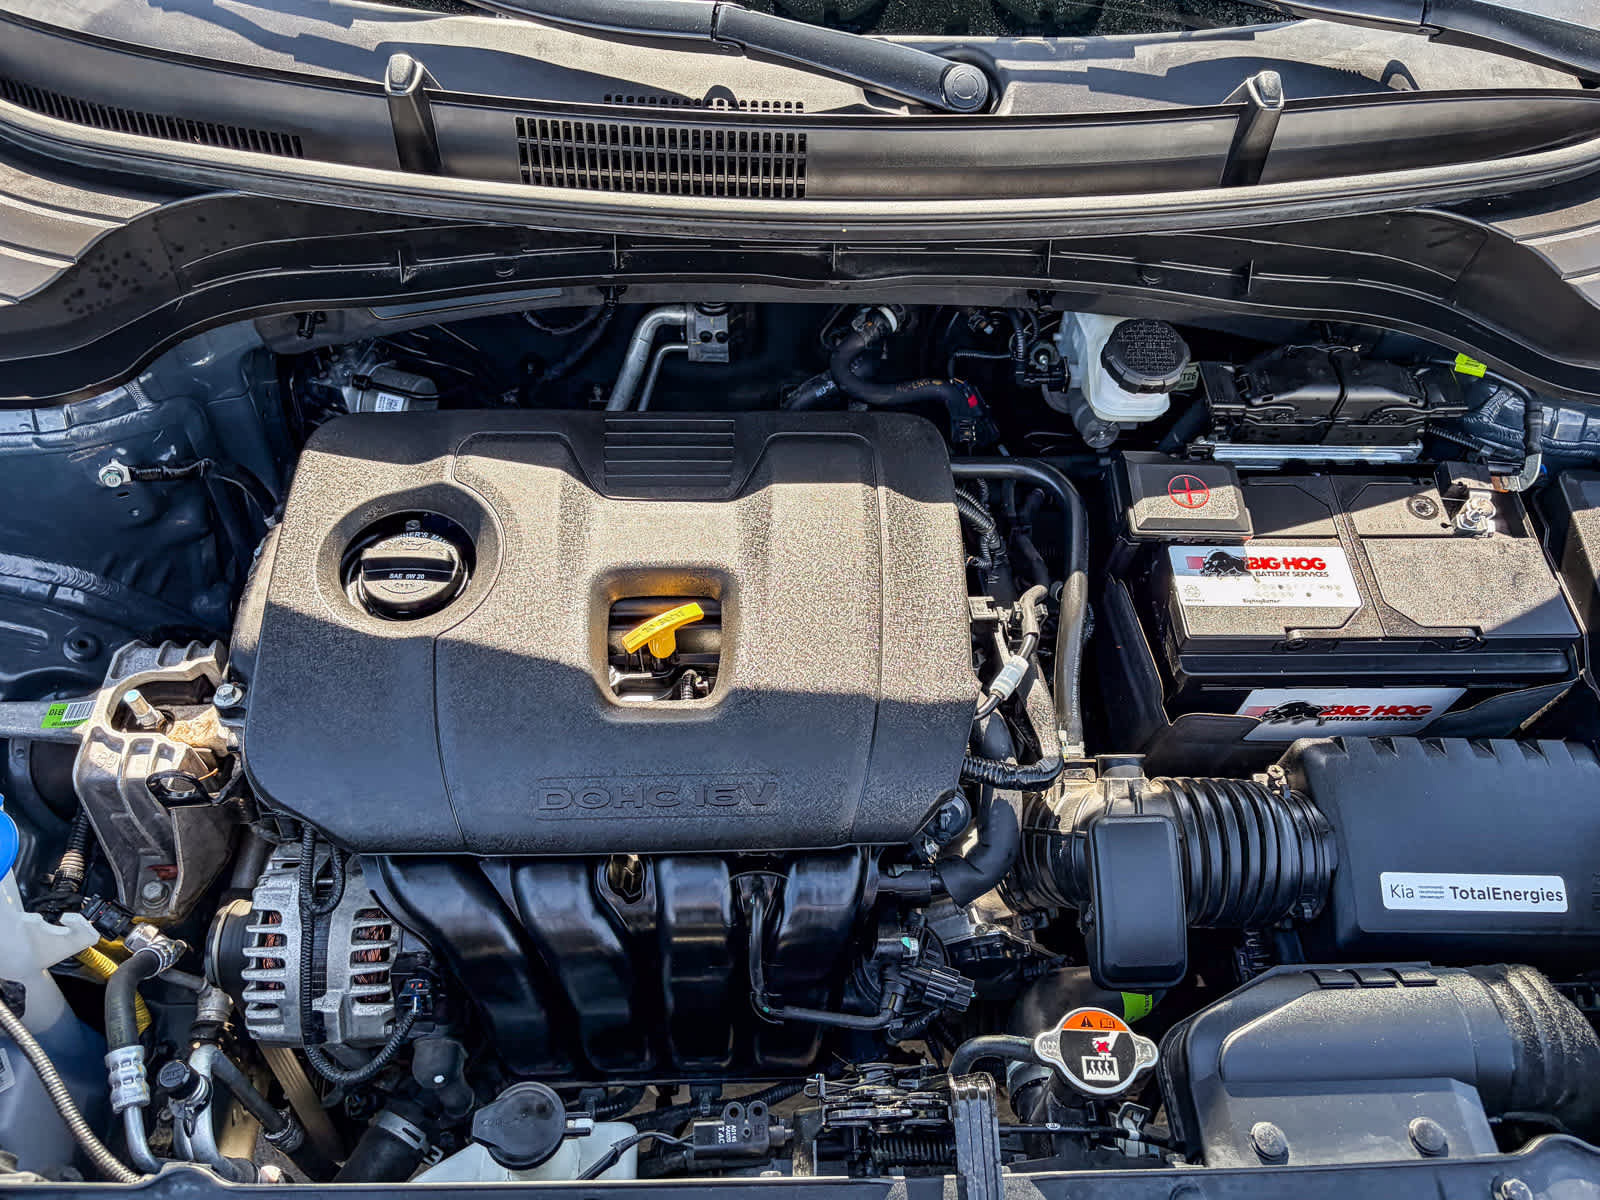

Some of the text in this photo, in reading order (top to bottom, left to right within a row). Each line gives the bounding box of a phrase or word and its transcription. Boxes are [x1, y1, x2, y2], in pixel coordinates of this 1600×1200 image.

[1246, 557, 1327, 571] BIG HOG
[1320, 705, 1433, 716] BIG HOG
[537, 782, 777, 810] DOHC 16V
[1390, 884, 1564, 904] Kia TotalEnergies
